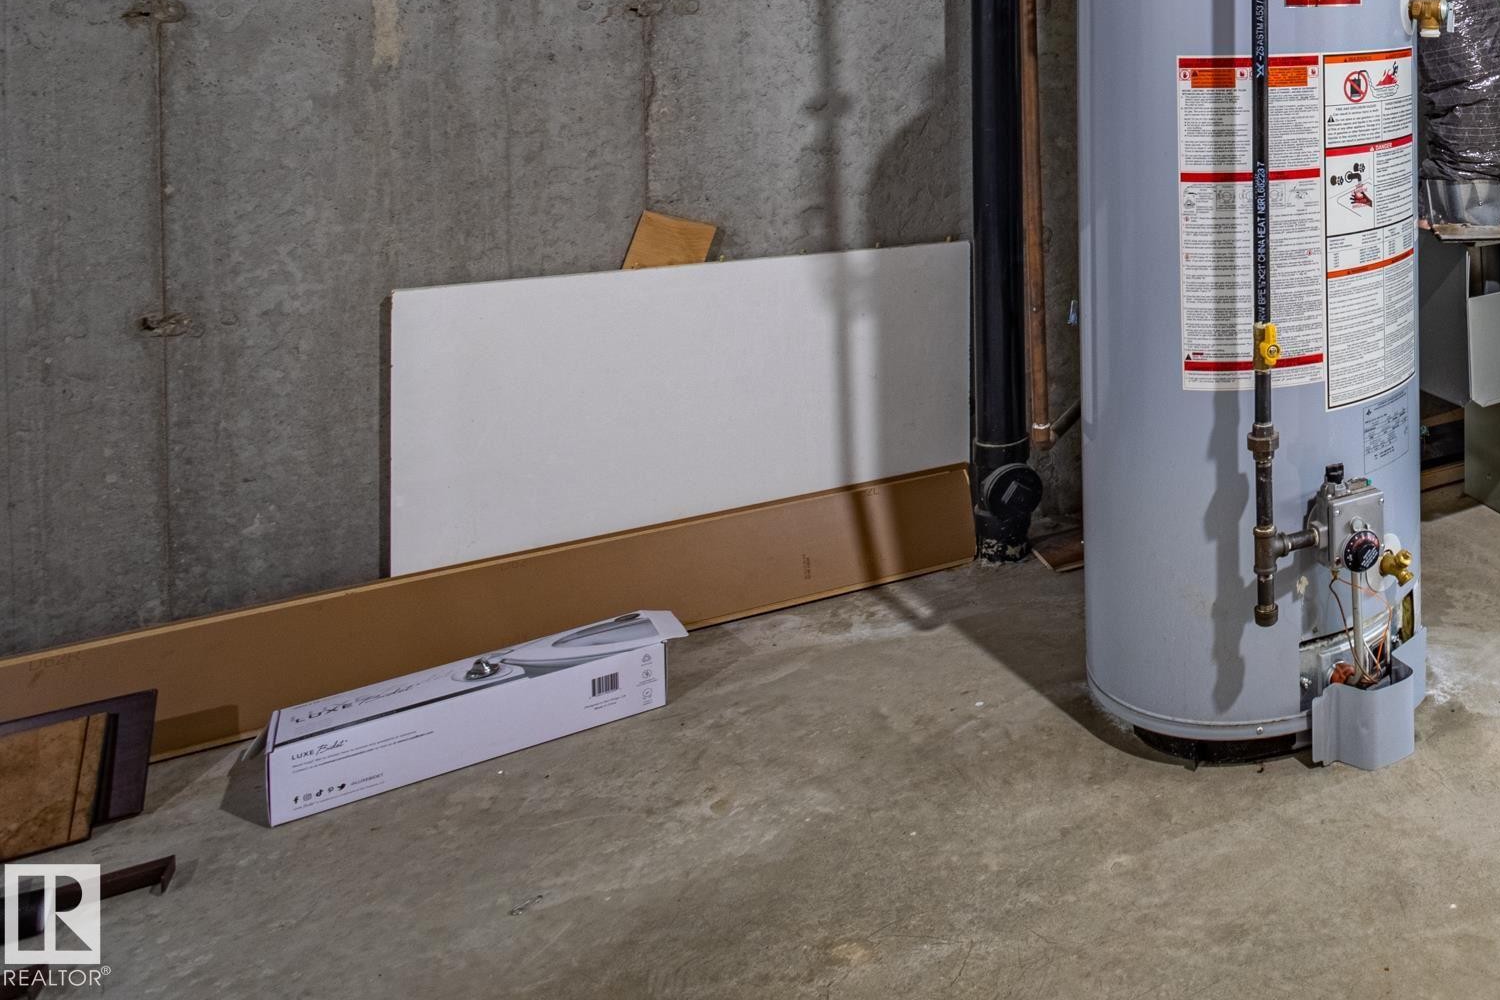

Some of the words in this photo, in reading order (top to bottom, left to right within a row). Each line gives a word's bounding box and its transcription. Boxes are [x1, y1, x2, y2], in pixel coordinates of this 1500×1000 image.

[1256, 4, 1265, 22] A53
[1256, 22, 1265, 46] ASTM
[1375, 142, 1393, 151] DANGER
[1257, 216, 1266, 238] HEAT
[1257, 239, 1266, 263] CHINA
[1257, 288, 1266, 305] BPE
[291, 749, 315, 761] LUXE
